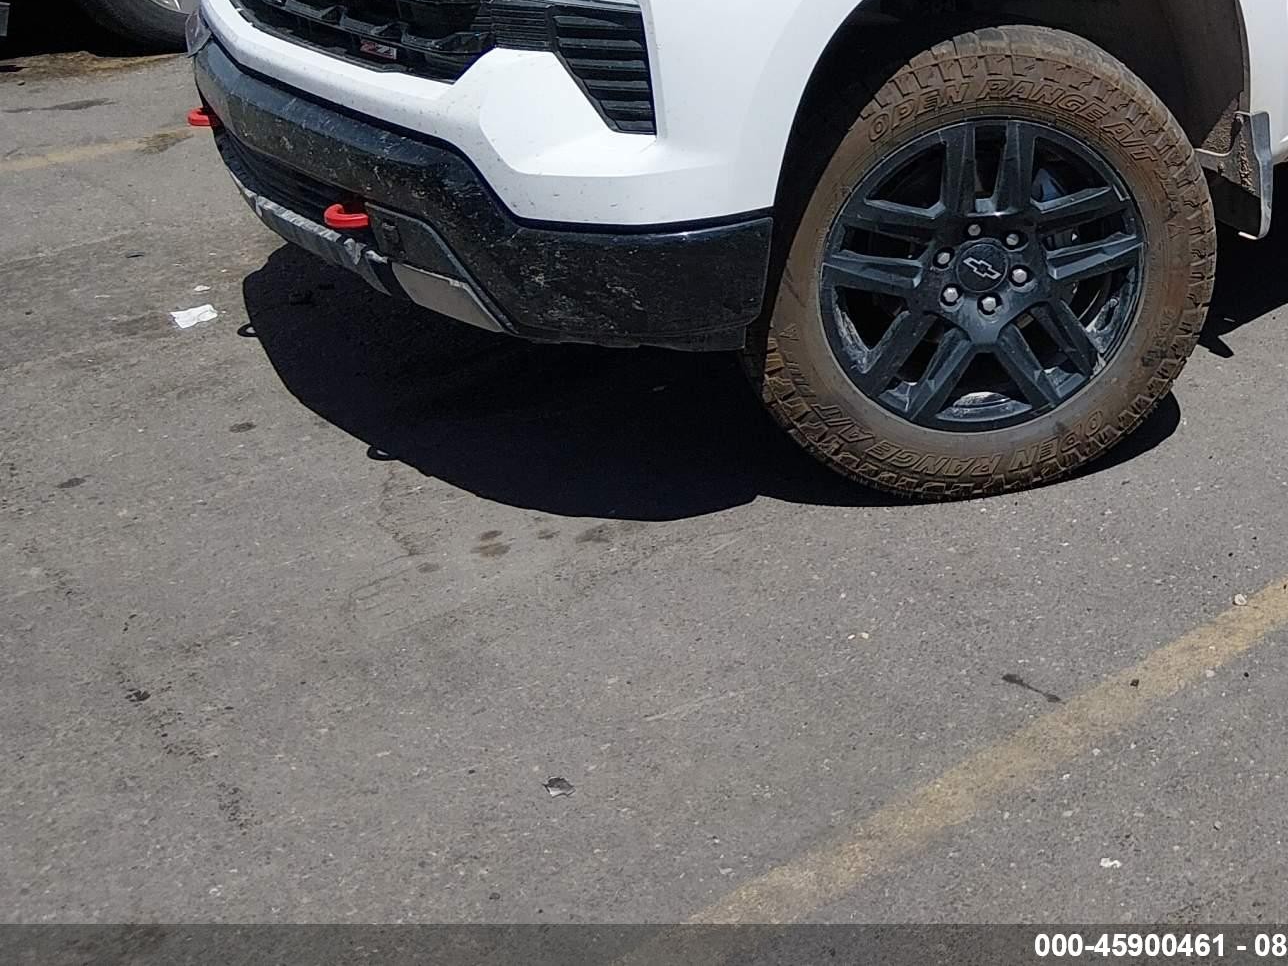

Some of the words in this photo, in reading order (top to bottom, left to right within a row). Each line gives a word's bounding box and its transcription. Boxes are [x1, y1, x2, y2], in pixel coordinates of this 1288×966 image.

[868, 81, 970, 142] OPEN
[976, 78, 1108, 123] RANGE
[1101, 121, 1159, 162] A/T
[864, 439, 1000, 478] RANGE
[1008, 410, 1104, 472] OPEN
